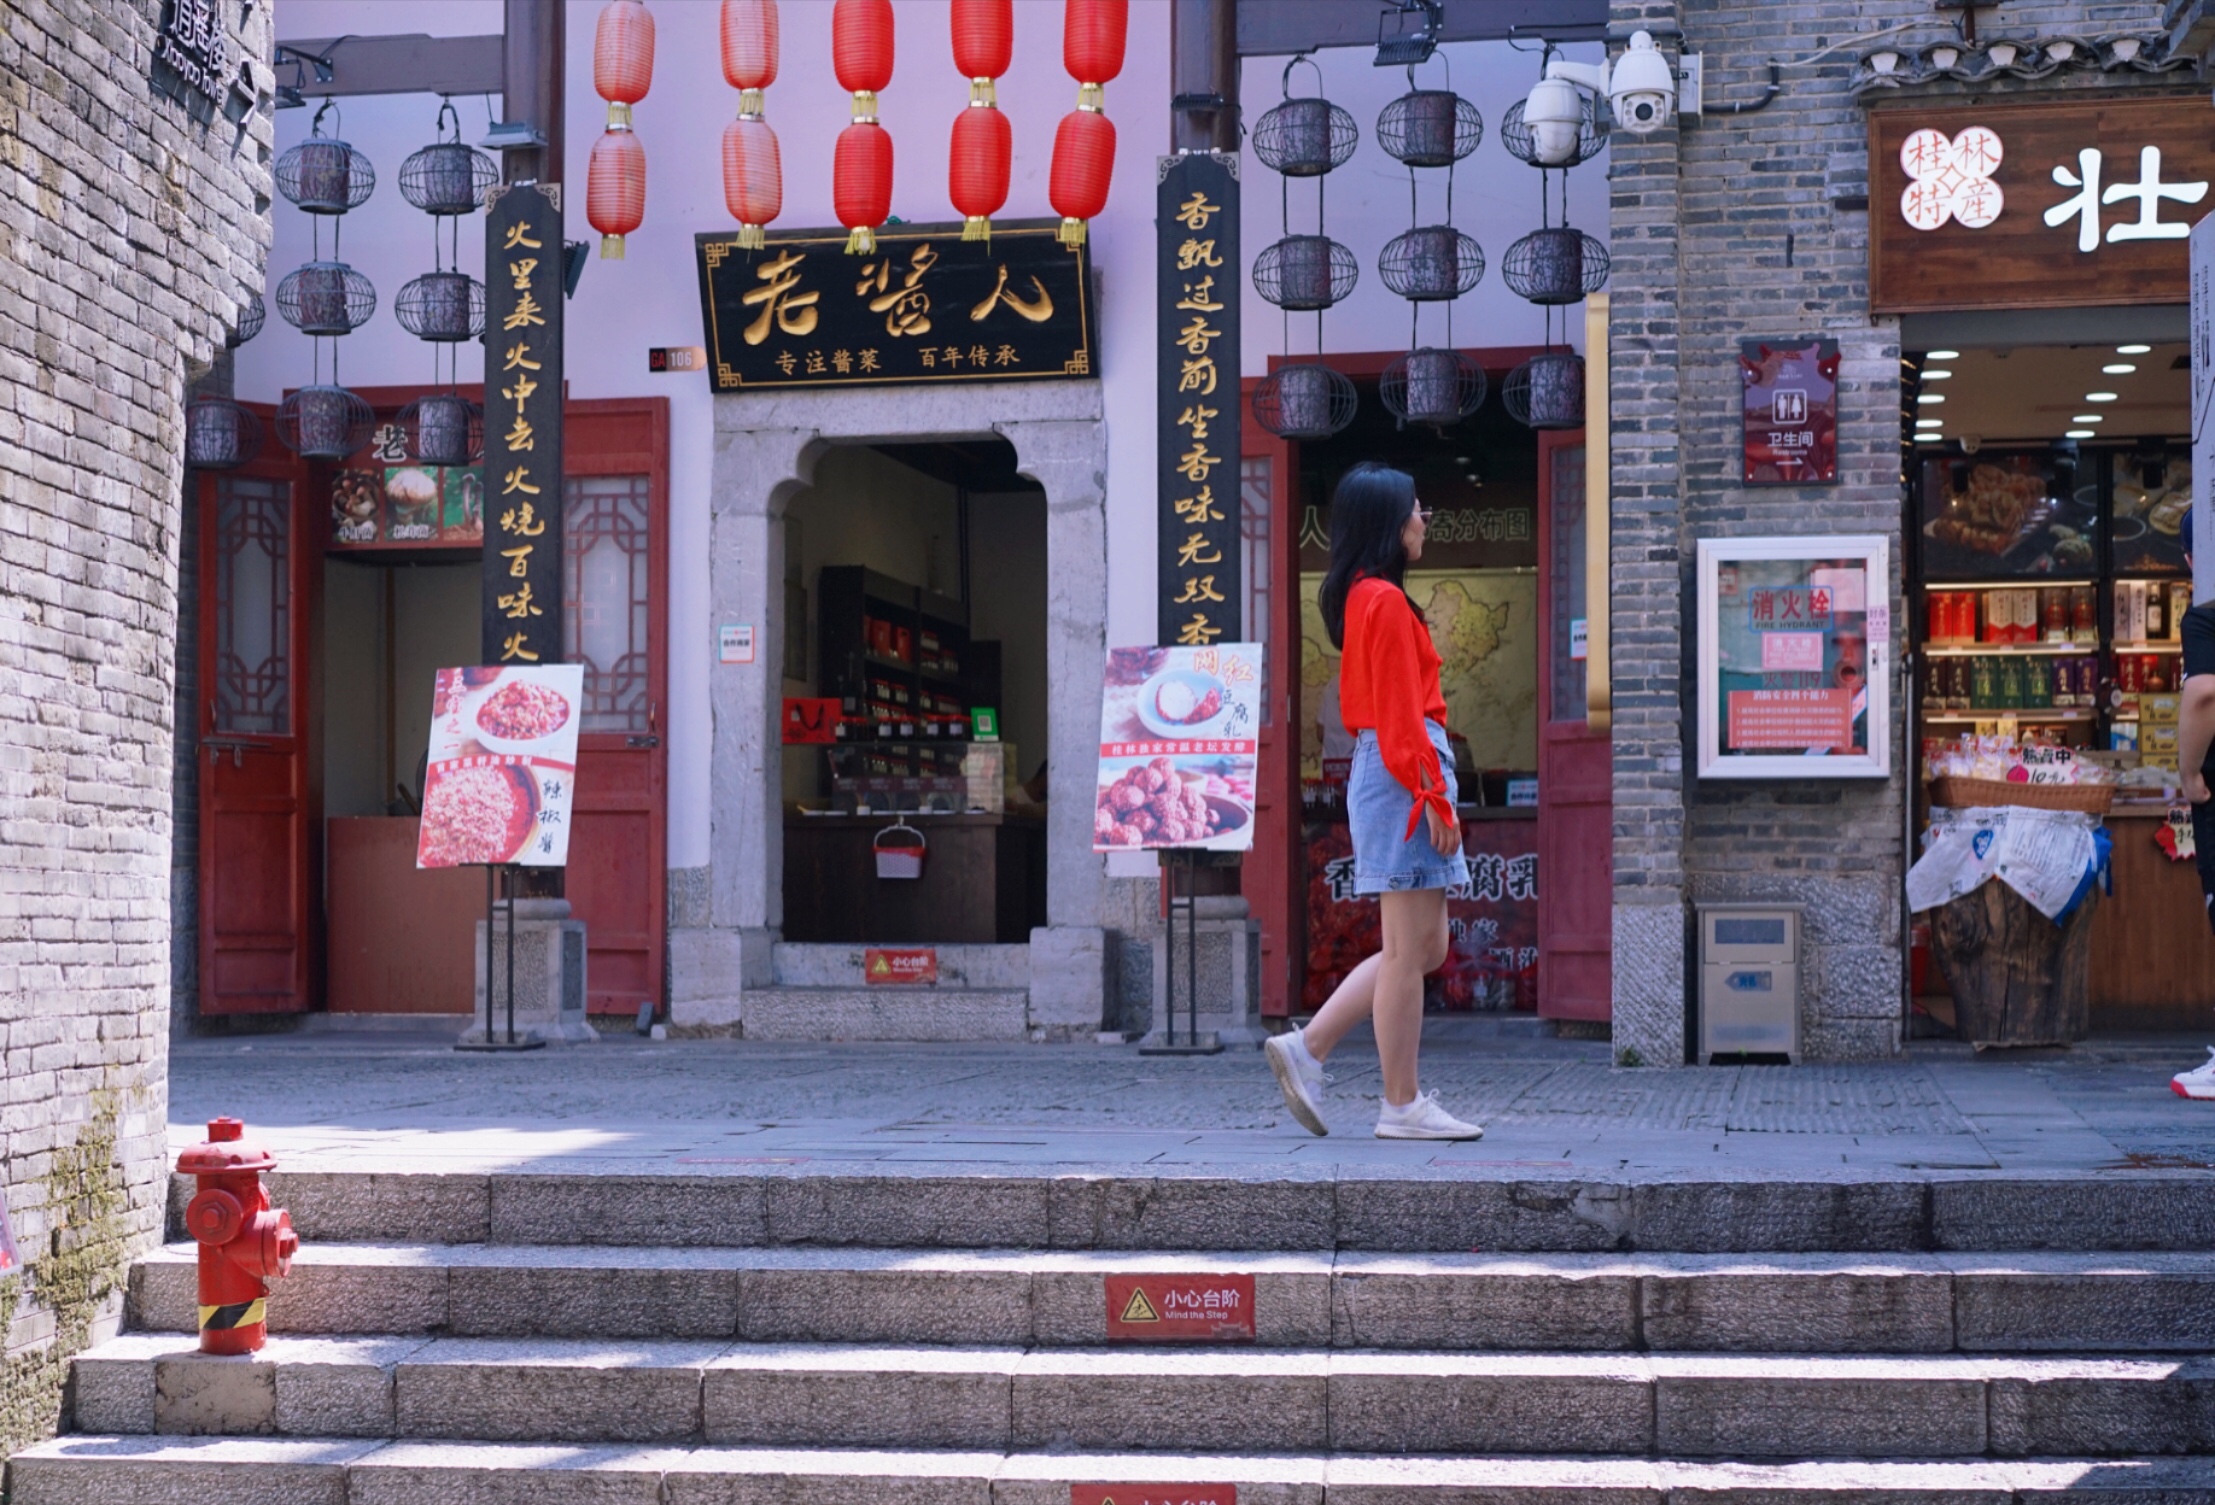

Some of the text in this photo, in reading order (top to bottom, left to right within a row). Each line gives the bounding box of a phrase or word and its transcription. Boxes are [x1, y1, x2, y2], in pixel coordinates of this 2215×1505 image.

[1906, 132, 2001, 176] 桂林
[671, 351, 692, 367] 106
[917, 344, 1021, 369] 百年传承
[1767, 431, 1813, 447] 卫生间
[1753, 589, 1830, 620] 消火栓
[1756, 620, 1825, 630] FIRE HYDRANT
[1164, 1289, 1240, 1308] 小心台阶
[1165, 1311, 1228, 1321] Mind the Step
